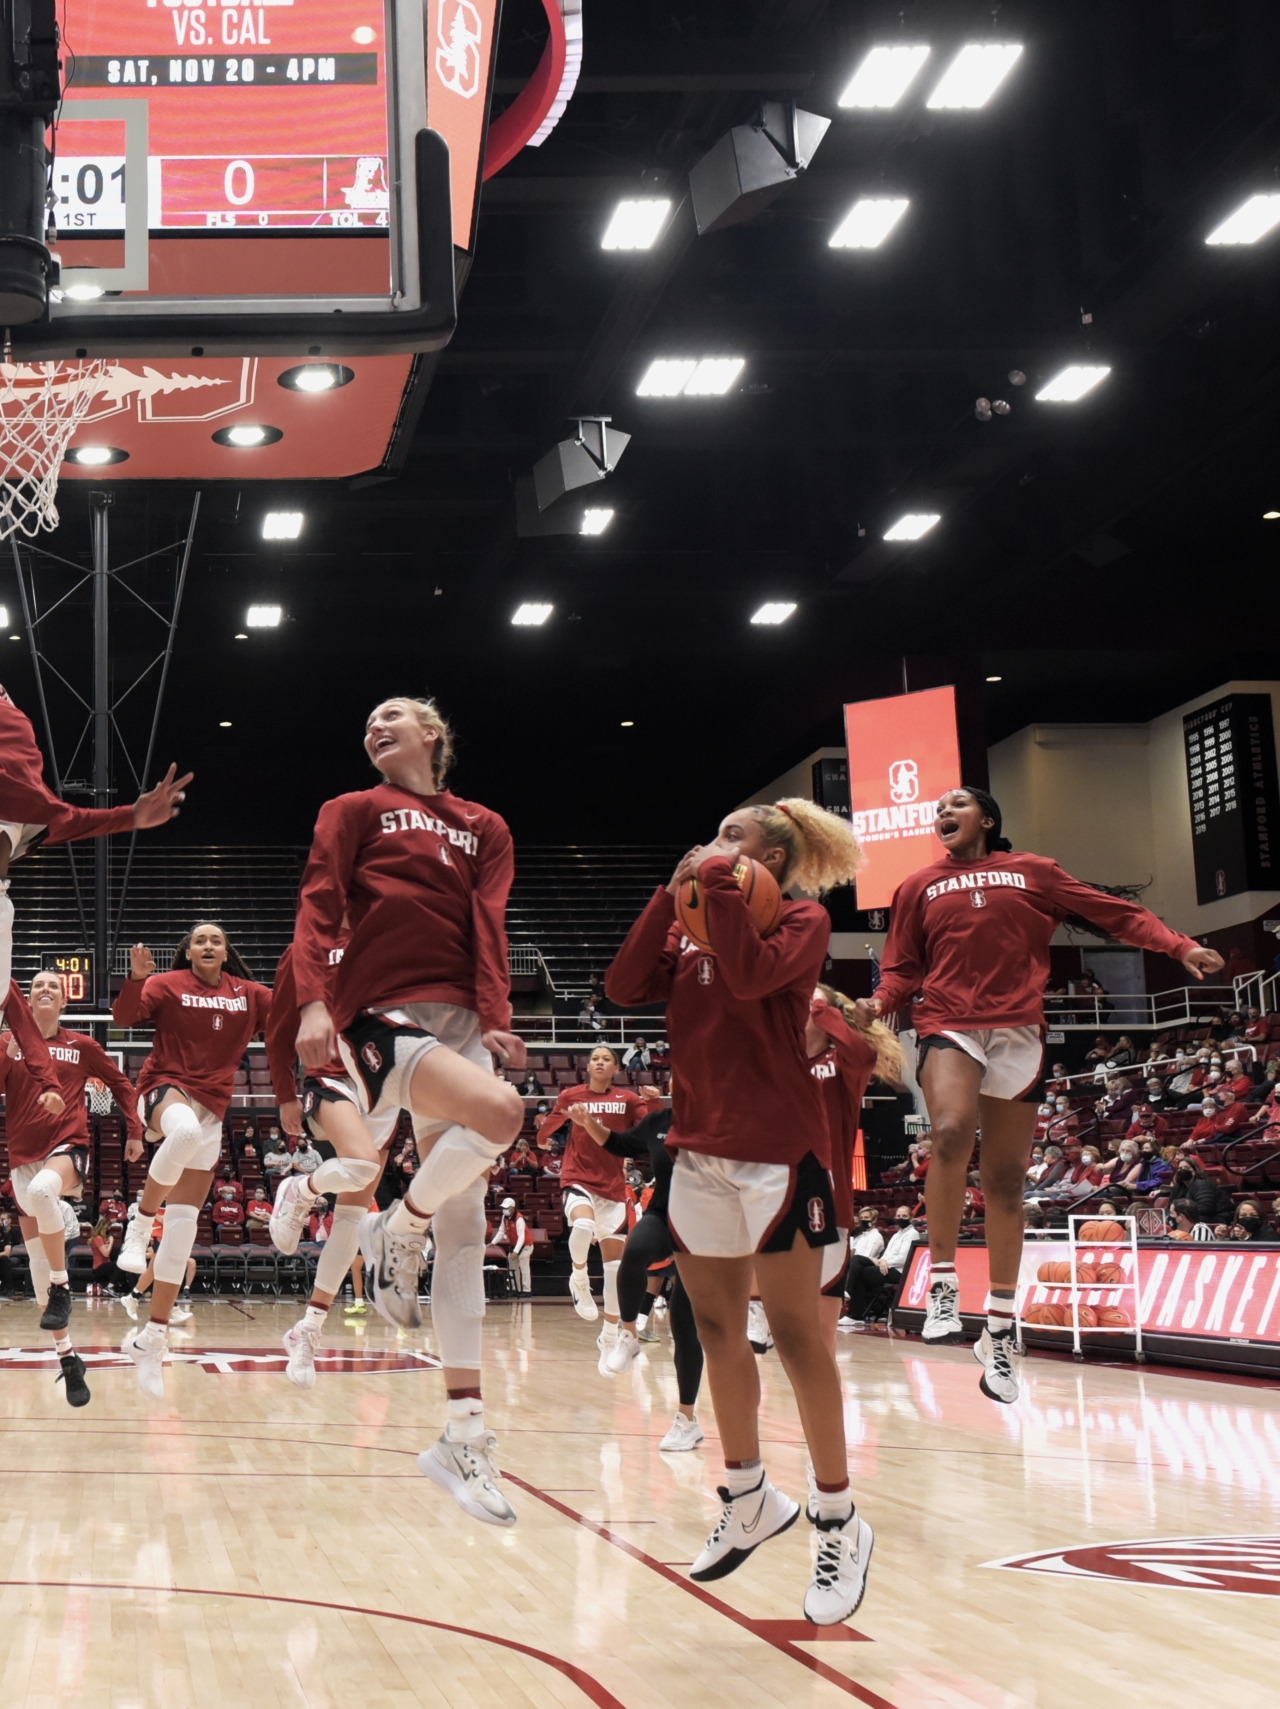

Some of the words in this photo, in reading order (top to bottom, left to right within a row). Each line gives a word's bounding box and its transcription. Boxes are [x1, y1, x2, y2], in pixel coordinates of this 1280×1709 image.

[172, 9, 213, 45] VS.
[221, 9, 271, 45] CAL
[107, 60, 158, 85] SAT,
[169, 60, 215, 82] NOV
[225, 59, 255, 82] 20
[286, 57, 336, 81] 4PM
[224, 160, 255, 205] 0
[62, 213, 97, 227] 1ST
[206, 214, 236, 227] FLS
[258, 213, 269, 226] 0
[329, 213, 362, 227] TOL
[375, 213, 387, 227] 4
[1248, 715, 1265, 789] ATHLETICS
[852, 800, 939, 836] STANFO
[1255, 797, 1271, 868] STANFORD
[926, 871, 1026, 901] STANFORD
[56, 957, 89, 972] 4:01
[181, 993, 248, 1012] STANFORD
